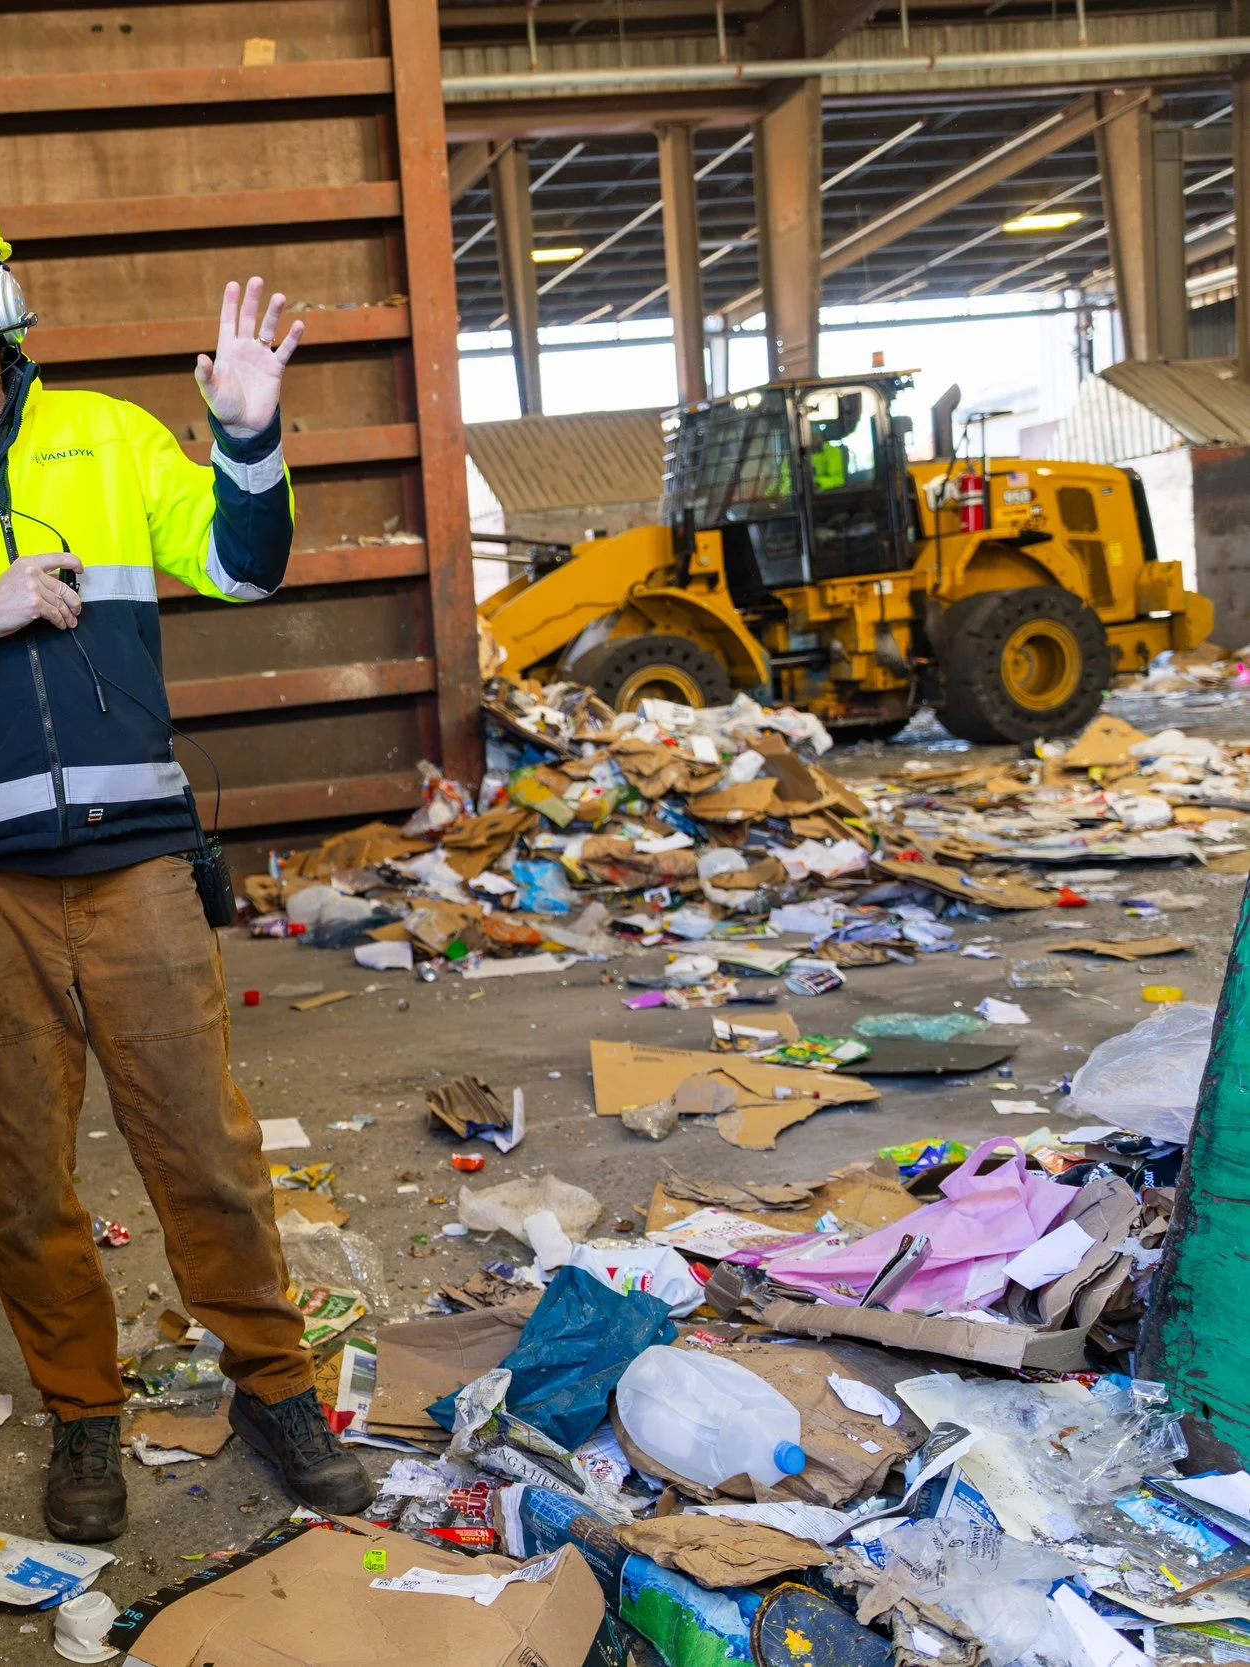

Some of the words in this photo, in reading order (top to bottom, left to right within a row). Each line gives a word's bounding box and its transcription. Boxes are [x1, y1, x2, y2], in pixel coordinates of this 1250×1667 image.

[41, 451, 66, 461] VAN
[69, 448, 95, 457] DYK
[518, 1463, 528, 1476] A
[475, 1529, 489, 1537] NO
[56, 1551, 88, 1567] prime
